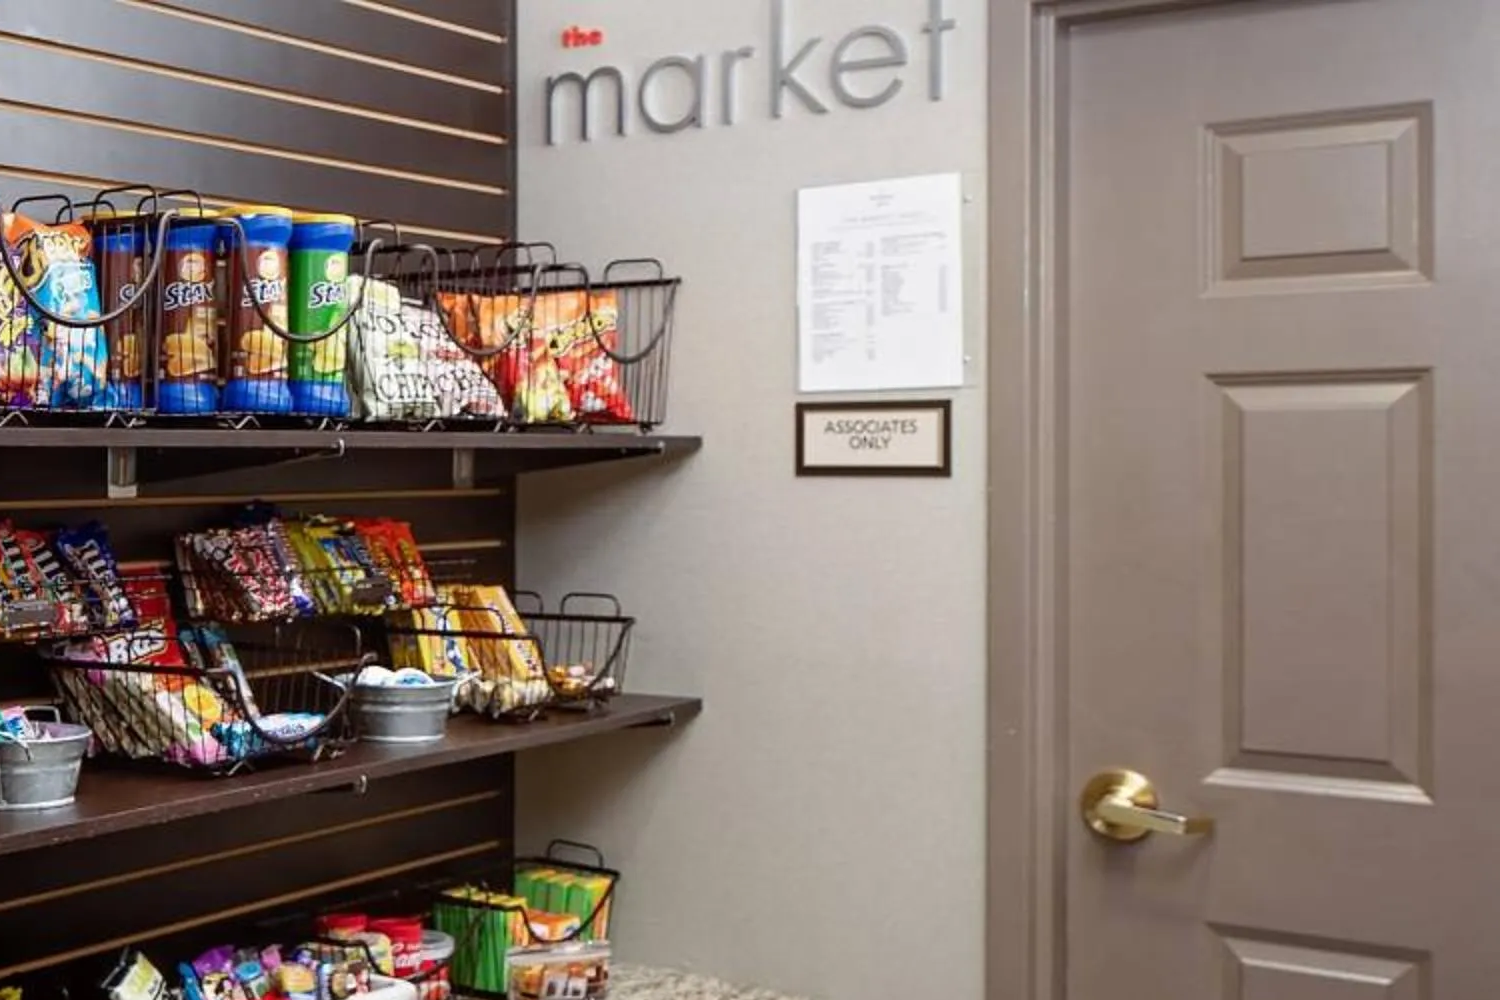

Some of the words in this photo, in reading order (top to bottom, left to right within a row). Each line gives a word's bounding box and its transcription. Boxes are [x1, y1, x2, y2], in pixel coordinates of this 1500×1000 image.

[559, 25, 602, 48] the
[545, 0, 957, 146] market
[823, 418, 918, 435] ASSOCIATES
[849, 434, 892, 450] ONLY
